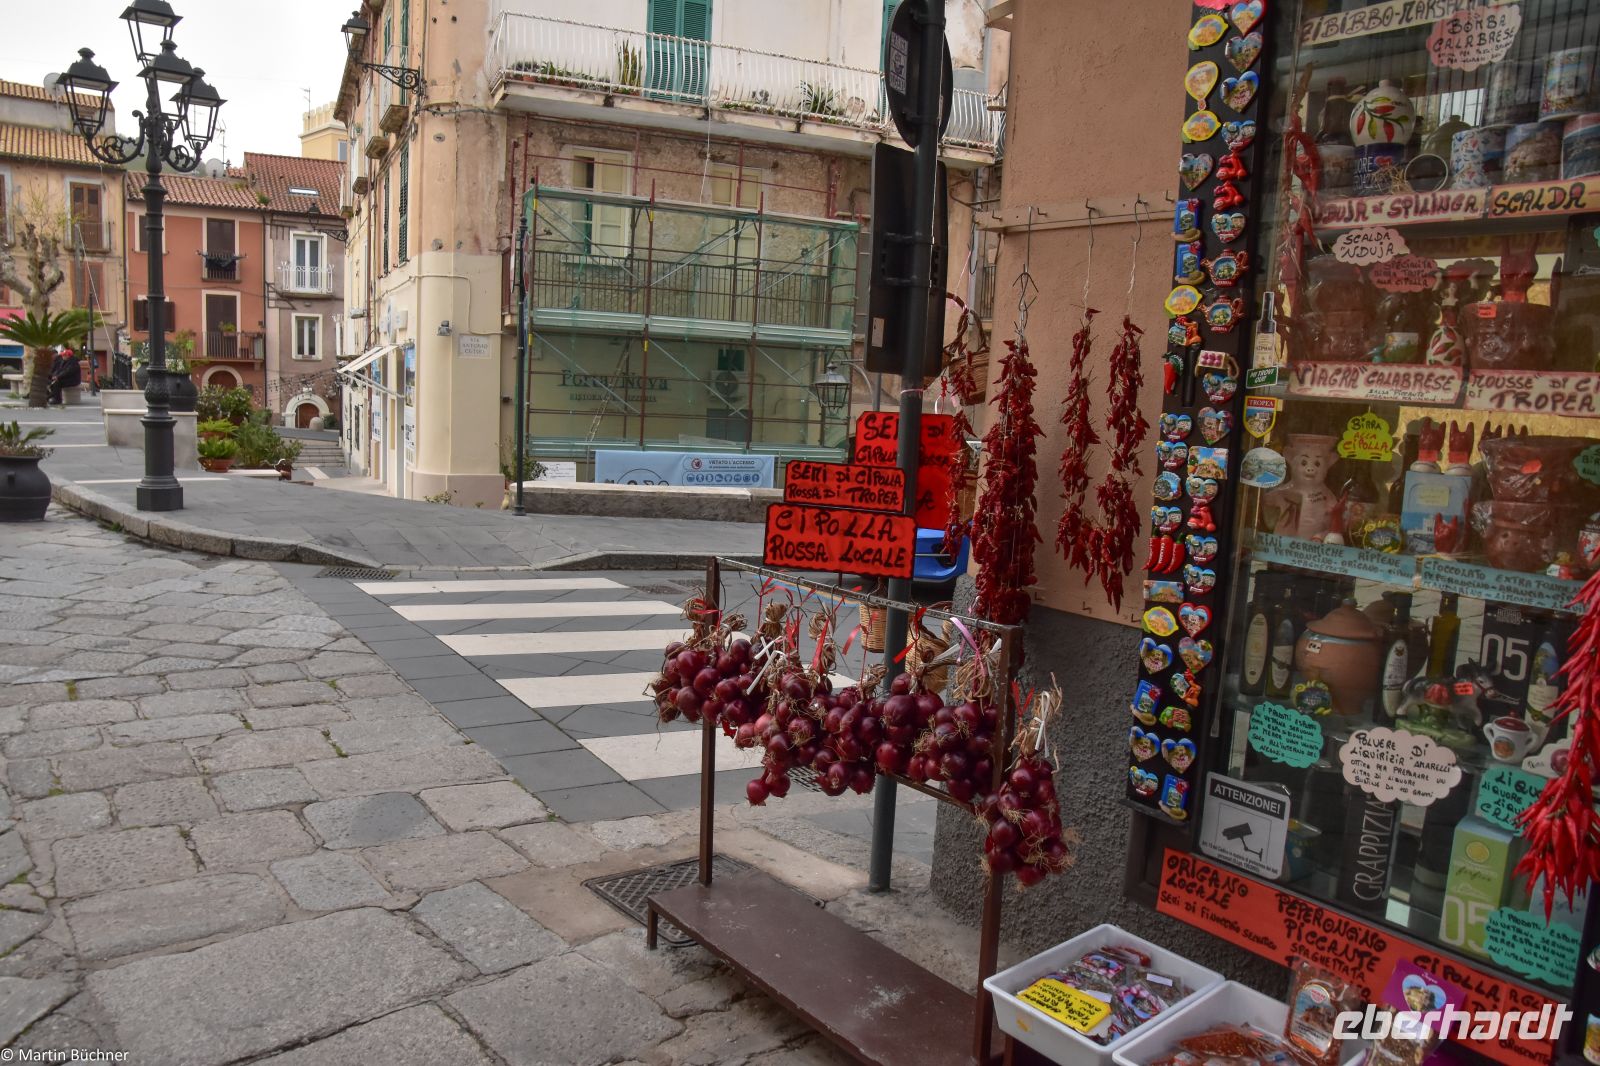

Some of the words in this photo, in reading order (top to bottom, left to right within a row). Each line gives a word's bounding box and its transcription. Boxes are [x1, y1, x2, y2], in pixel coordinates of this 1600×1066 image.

[1447, 14, 1506, 34] BOMBA
[1432, 28, 1514, 52] CALABRESE
[1386, 191, 1480, 219] SPILINGA
[1492, 182, 1589, 218] SCALDA
[1343, 231, 1391, 245] SCALDA
[1366, 370, 1456, 392] CALABRESE
[1247, 400, 1274, 408] TROPEA
[1489, 389, 1596, 412] TROPEA
[1351, 417, 1382, 431] BIRRA
[1343, 438, 1389, 454] CIPOLLA
[791, 463, 827, 483] SEMI
[855, 466, 903, 488] CIPOLLA
[787, 483, 822, 499] ROSSA
[845, 486, 900, 505] TROPEA
[775, 507, 898, 543] CIPOLLA
[770, 534, 829, 562] ROSSA
[838, 541, 907, 568] LOCALE
[1289, 540, 1345, 558] CERAMICHE
[1358, 551, 1401, 568] RIPIENE
[1423, 561, 1487, 581] CIOCCOLATO
[1496, 574, 1533, 589] EXTRA
[1480, 633, 1529, 681] 05
[1355, 732, 1396, 750] POLVERE
[1213, 783, 1282, 815] ATTENZIONE!
[1481, 781, 1523, 805] LIQUORE
[1167, 855, 1249, 898] ORIGANO
[1160, 890, 1181, 905] SEMI
[1185, 902, 1197, 914] DI
[1166, 872, 1231, 910] LOCALE
[1275, 893, 1387, 953] PEPERONCINO
[1284, 919, 1381, 973] PICCANTE
[1413, 955, 1501, 1002] CIPOLLA
